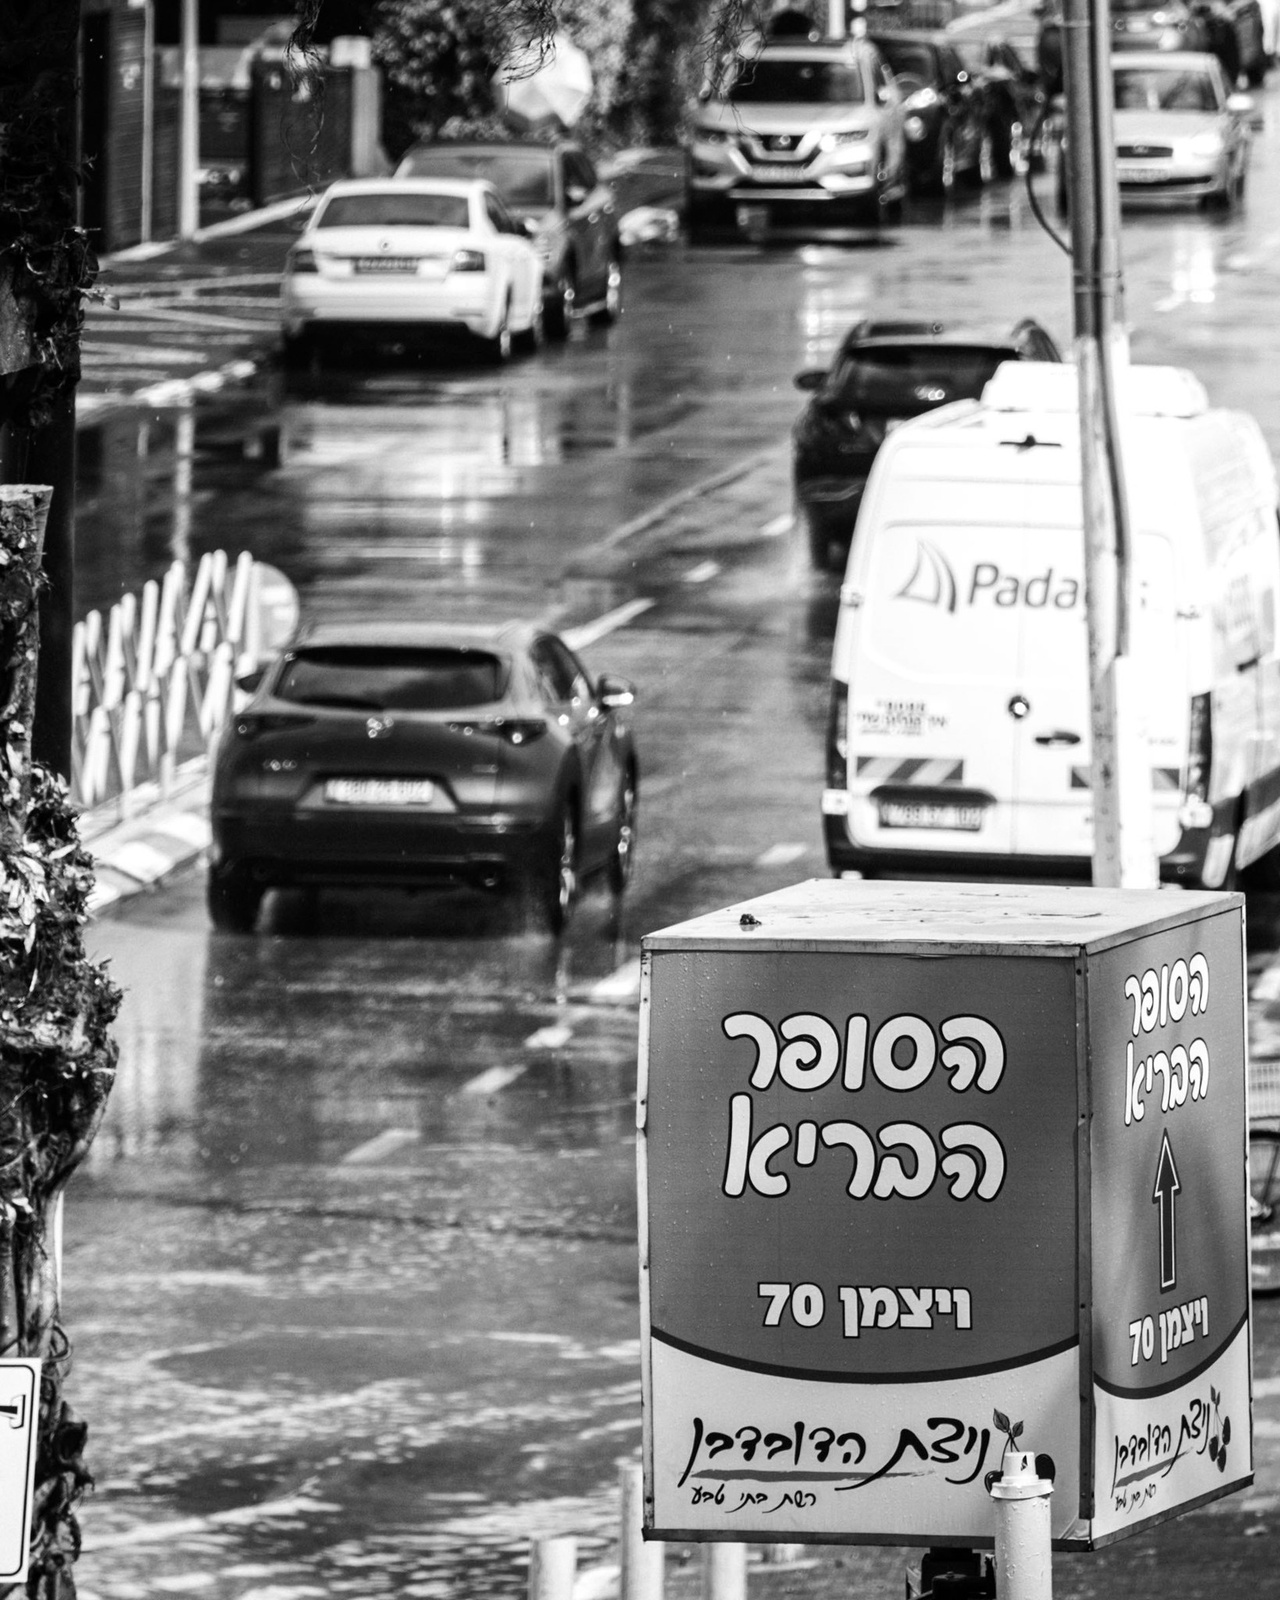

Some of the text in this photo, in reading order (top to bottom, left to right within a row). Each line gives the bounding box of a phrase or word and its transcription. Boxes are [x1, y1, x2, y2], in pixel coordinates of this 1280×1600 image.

[968, 562, 1081, 610] Pada
[1124, 951, 1209, 1037] הסופר
[722, 1011, 1007, 1092] הסופר
[1124, 1037, 1209, 1127] הבריא
[722, 1093, 1007, 1200] הבריא
[757, 1282, 974, 1338] ויצמן 70
[1129, 1295, 1209, 1367] ויצמן 70
[677, 1417, 991, 1491] ניצת הדובדבן
[1110, 1398, 1210, 1499] ניצת הדובדבן
